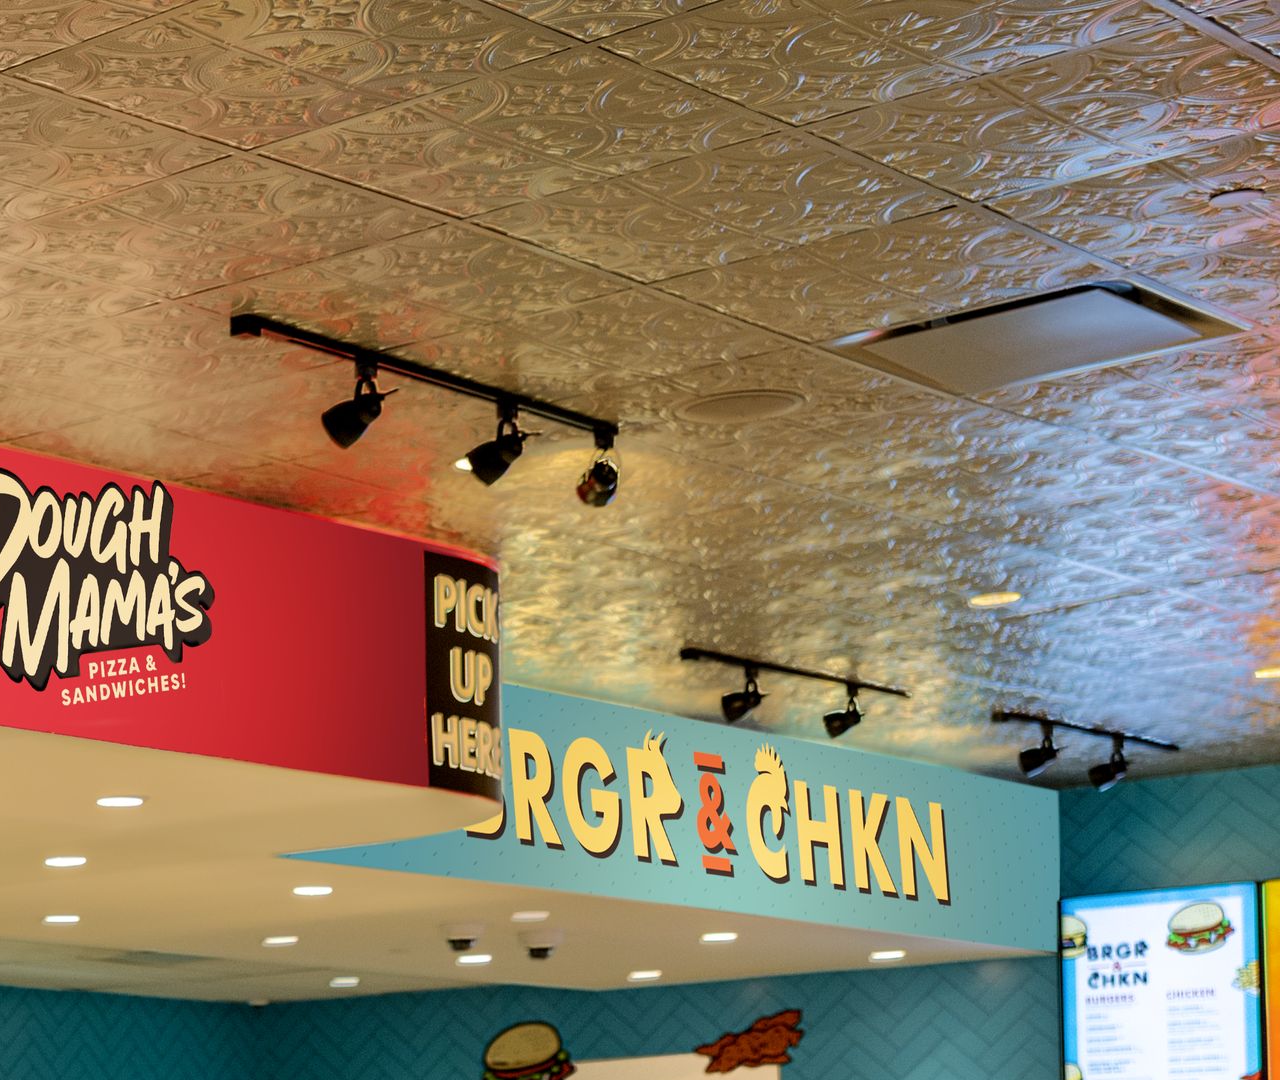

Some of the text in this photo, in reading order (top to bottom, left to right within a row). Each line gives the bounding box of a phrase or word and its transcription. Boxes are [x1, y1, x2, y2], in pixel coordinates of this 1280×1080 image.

[1, 557, 206, 677] MAMA'S
[434, 573, 500, 644] PICK
[61, 672, 187, 706] SANDWICHES!
[88, 654, 157, 680] PIZZA &
[449, 648, 493, 706] UP
[465, 727, 951, 905] RGR & CHKN
[1086, 940, 1149, 961] BRGR
[1087, 971, 1149, 989] CHKN
